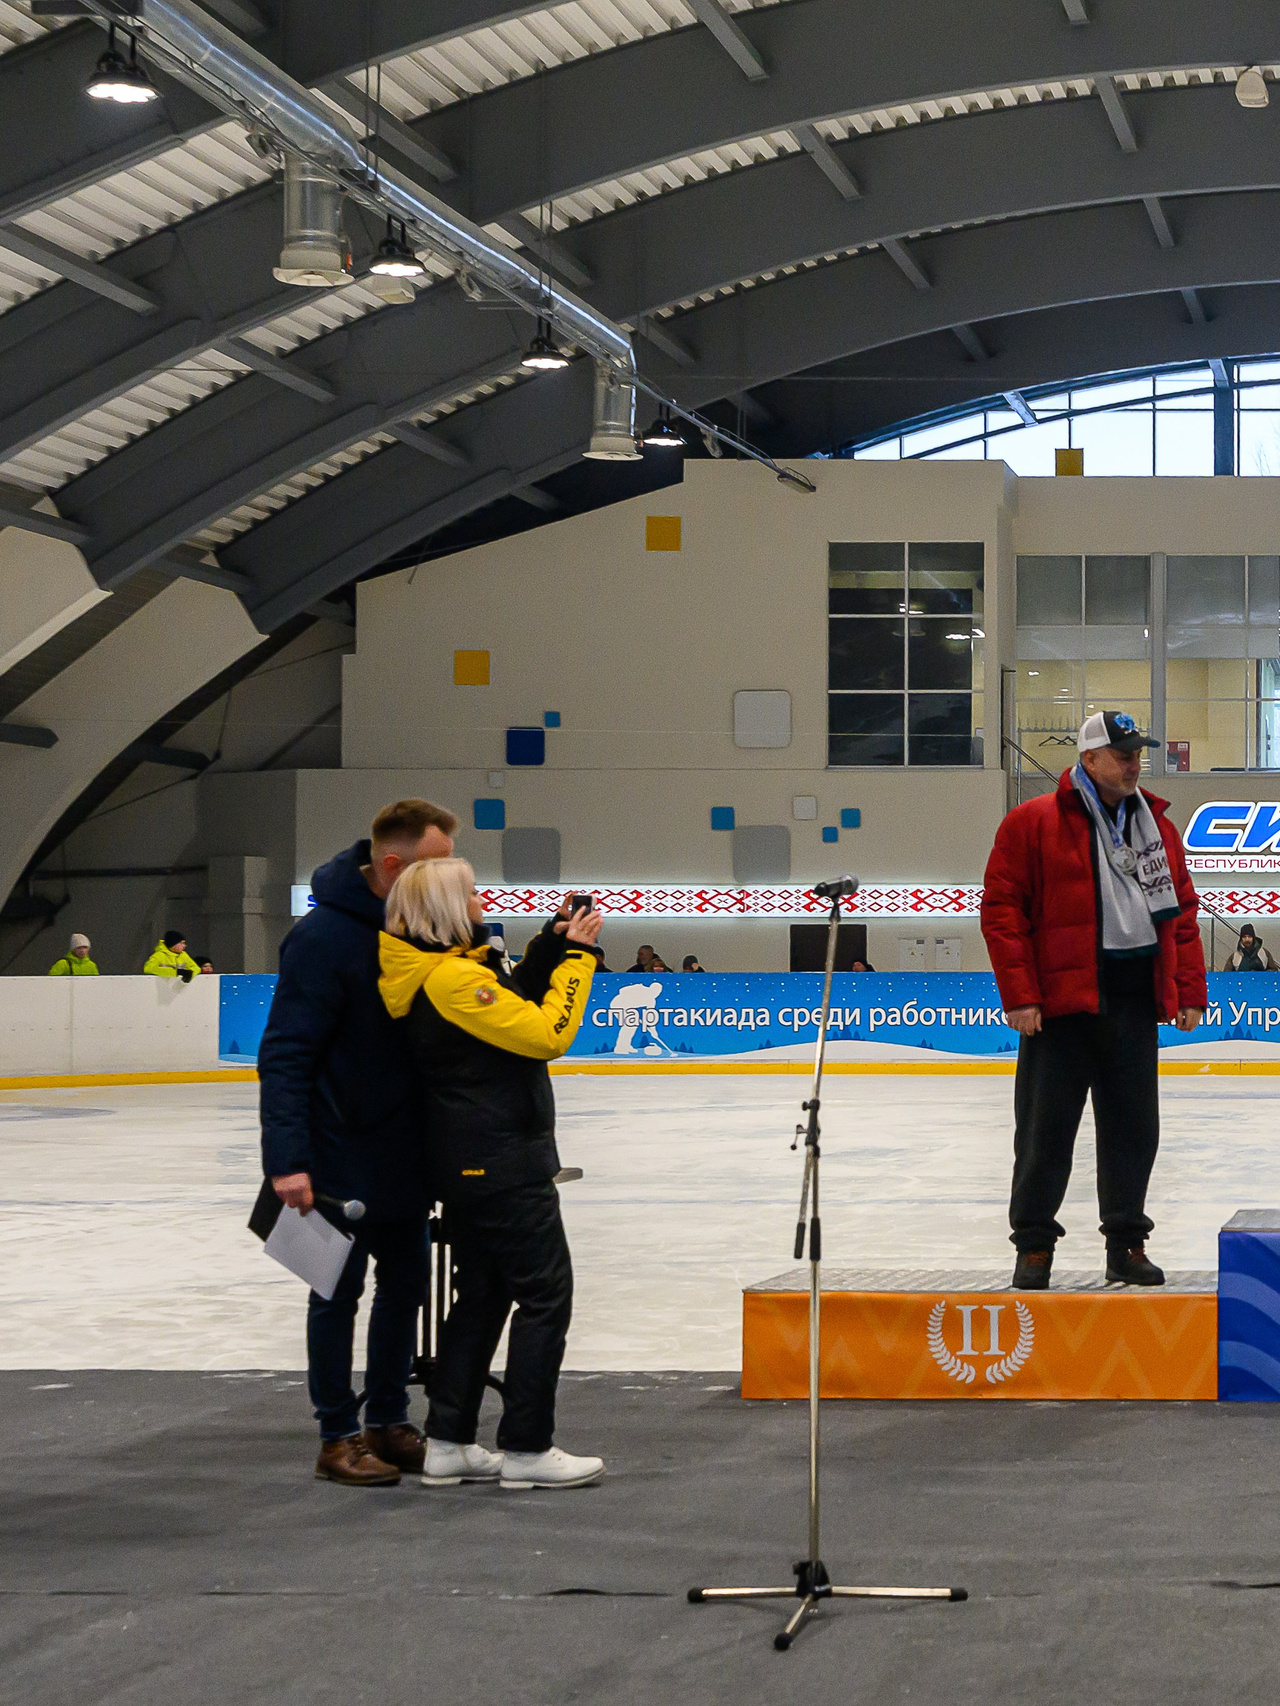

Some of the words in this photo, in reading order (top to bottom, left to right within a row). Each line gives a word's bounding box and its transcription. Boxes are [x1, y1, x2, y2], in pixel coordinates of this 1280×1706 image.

[592, 1007, 771, 1032] спартакиада
[778, 1007, 861, 1031] среди
[955, 1305, 1006, 1355] II
